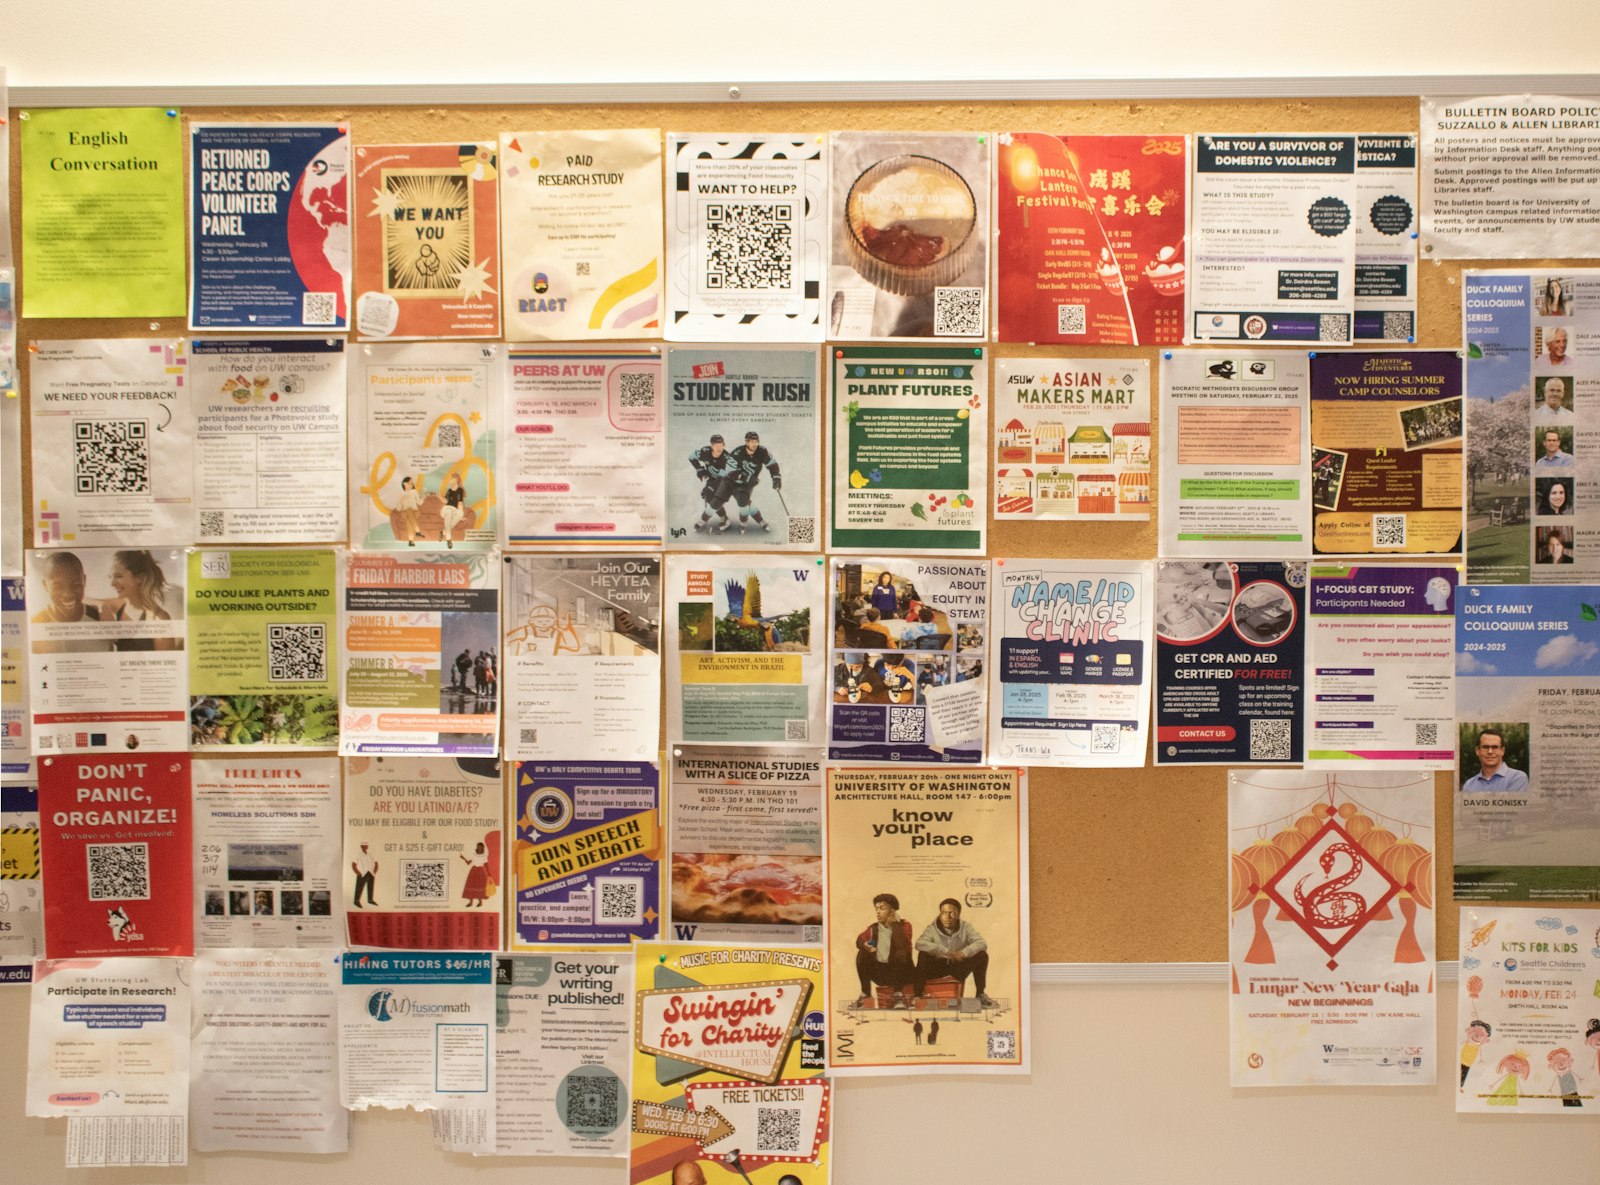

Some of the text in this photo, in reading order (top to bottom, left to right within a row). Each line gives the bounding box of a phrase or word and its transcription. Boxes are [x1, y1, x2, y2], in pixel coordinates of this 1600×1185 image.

[1446, 108, 1600, 117] BULLETIN BOARD POLIC
[1438, 122, 1496, 130] SUZZALLO
[69, 132, 128, 148] English
[1209, 141, 1344, 151] ARE YOU A SURVIVOR OF
[51, 157, 158, 172] Conversation
[202, 149, 270, 169] RETURNED
[566, 156, 593, 167] PAID
[1215, 156, 1337, 166] DOMESTIC VIOLENCE?
[202, 171, 290, 192] PEACE CORPS
[538, 173, 624, 186] RESEARCH STUDY
[698, 185, 797, 194] WANT TO HELP?
[1040, 180, 1078, 194] Lantern
[202, 194, 277, 214] VOLUNTEER
[1017, 195, 1069, 207] Festival
[394, 208, 464, 221] WE WANT
[202, 216, 245, 235] PANEL
[416, 227, 444, 240] YOU
[518, 299, 567, 312] REACT
[513, 365, 606, 377] PEERS AT UW
[1007, 373, 1101, 386] ASUW ASIAN
[1335, 376, 1445, 385] NOW HIRING SUMMER
[44, 393, 60, 401] WE
[62, 393, 88, 401] NEED
[121, 392, 177, 400] FEEDBACK!
[673, 383, 810, 402] STUDENT RUSH
[848, 385, 973, 396] PLANT FUTURES
[1017, 389, 1135, 404] MAKERS MART
[1340, 387, 1440, 396] CAMP COUNSELORS
[595, 562, 651, 574] Join Our
[918, 566, 986, 576] PASSIONATE
[353, 569, 465, 584] FRIDAY HARBOR LABS
[591, 576, 650, 587] HEYTEA
[793, 570, 809, 581] W
[949, 582, 986, 590] ABOUT
[1316, 586, 1415, 594] I-FOCUS CBT STUDY:
[196, 590, 212, 598] DO
[214, 590, 238, 598] YOU
[264, 589, 305, 597] PLANTS
[307, 589, 330, 597] AND
[608, 588, 651, 603] Family
[933, 595, 985, 604] EQUITY IN
[1012, 579, 1135, 608] NAME/ID
[209, 603, 317, 611] WORKING OUTSIDE?
[1316, 599, 1369, 609] Participants
[950, 609, 985, 618] STEM?
[1019, 600, 1127, 628] CHANGE
[1464, 621, 1569, 632] COLLOQUIUM SERIES
[1026, 620, 1119, 646] CLINIC
[1464, 643, 1506, 651] 2024-2025
[1175, 654, 1278, 663] GET CPR AND AED
[1175, 669, 1292, 679] CERTIFIED FOR FREE!
[678, 759, 819, 771] INTERNATIONAL STUDIES
[78, 764, 148, 780] DON'T
[685, 771, 716, 779] WITH
[727, 772, 757, 780] SLICE
[760, 772, 774, 780] OF
[777, 772, 810, 781] PIZZA
[370, 786, 483, 798] DO YOU HAVE DIABETES?
[835, 783, 1011, 791] UNIVERSITY OF WASHINGTON
[77, 787, 152, 804] PANIC,
[373, 802, 479, 813] ARE YOU LATINO/A/E?
[1464, 799, 1528, 807] DAVID KONISKY
[53, 809, 177, 826] ORGANIZE!
[893, 808, 953, 822] know
[872, 823, 925, 837] your
[531, 819, 640, 866] JOIN SPEECH
[911, 833, 973, 849] place
[201, 845, 222, 853] 206
[203, 855, 219, 863] 317
[537, 836, 644, 881] AND DEBATE
[1501, 942, 1578, 953] KITS FOR KIDS
[344, 960, 441, 969] HIRING TUTORS
[680, 950, 822, 972] MUSIC FOR CHARITY PRESENTS
[1520, 960, 1547, 968] Seattle
[554, 962, 619, 977] Get your
[560, 978, 613, 992] writing
[48, 987, 176, 997] Participate in Research!
[548, 993, 624, 1006] published!
[412, 1002, 470, 1015] fusionmath
[664, 988, 784, 1027] Swingin'
[660, 1023, 784, 1048] for Charity
